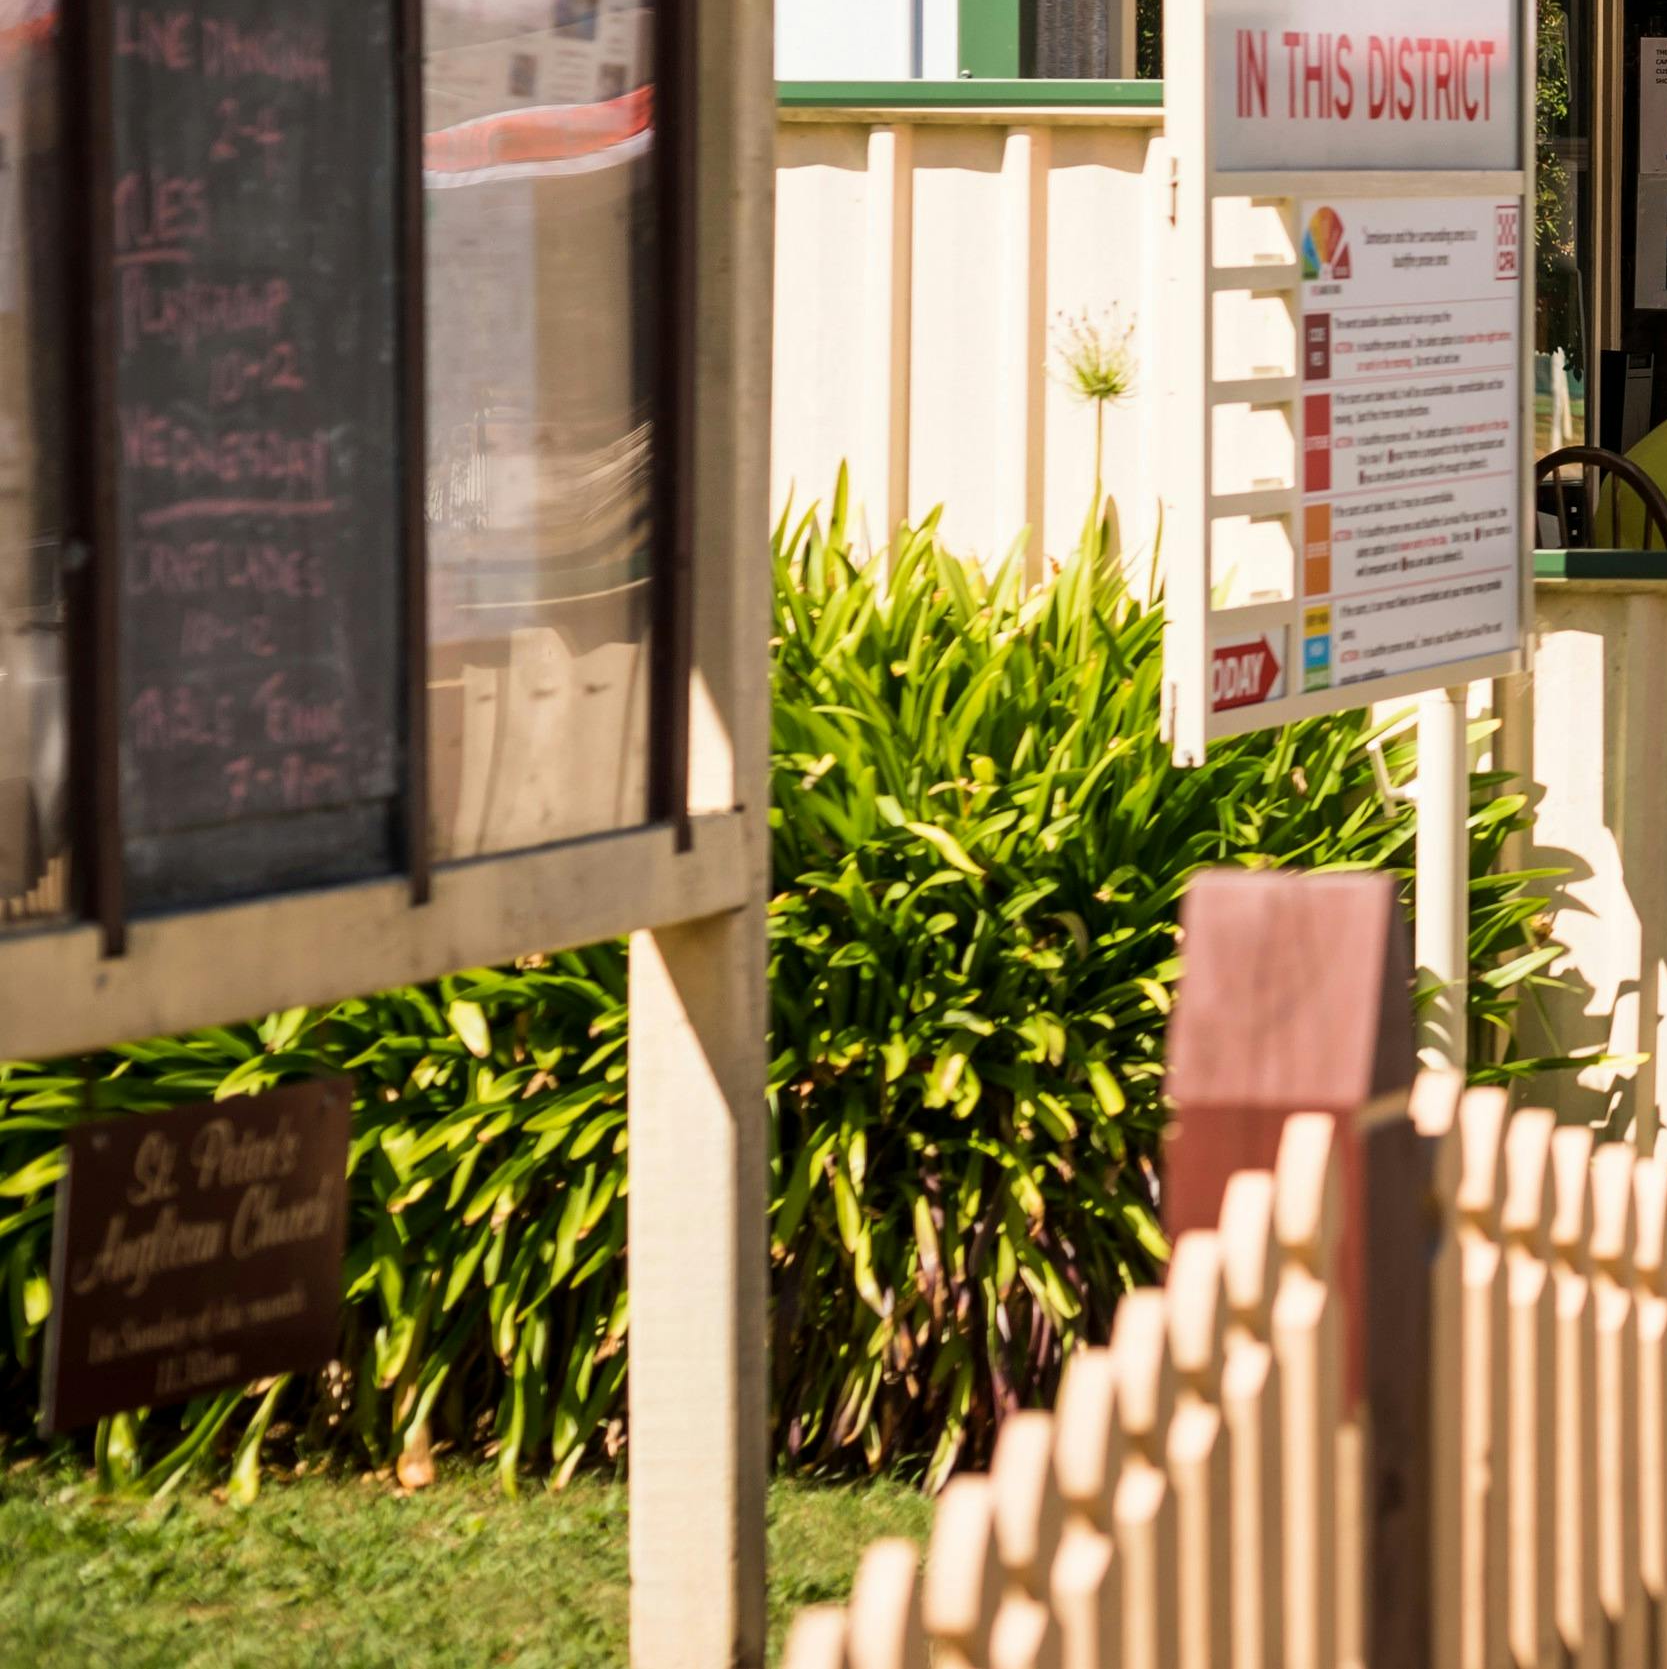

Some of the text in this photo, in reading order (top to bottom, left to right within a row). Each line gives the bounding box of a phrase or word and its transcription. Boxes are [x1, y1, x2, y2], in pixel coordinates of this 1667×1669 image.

[1236, 29, 1496, 122] IN THIS DISTRICT
[1211, 651, 1266, 702] ODAY
[230, 1173, 335, 1260] Church
